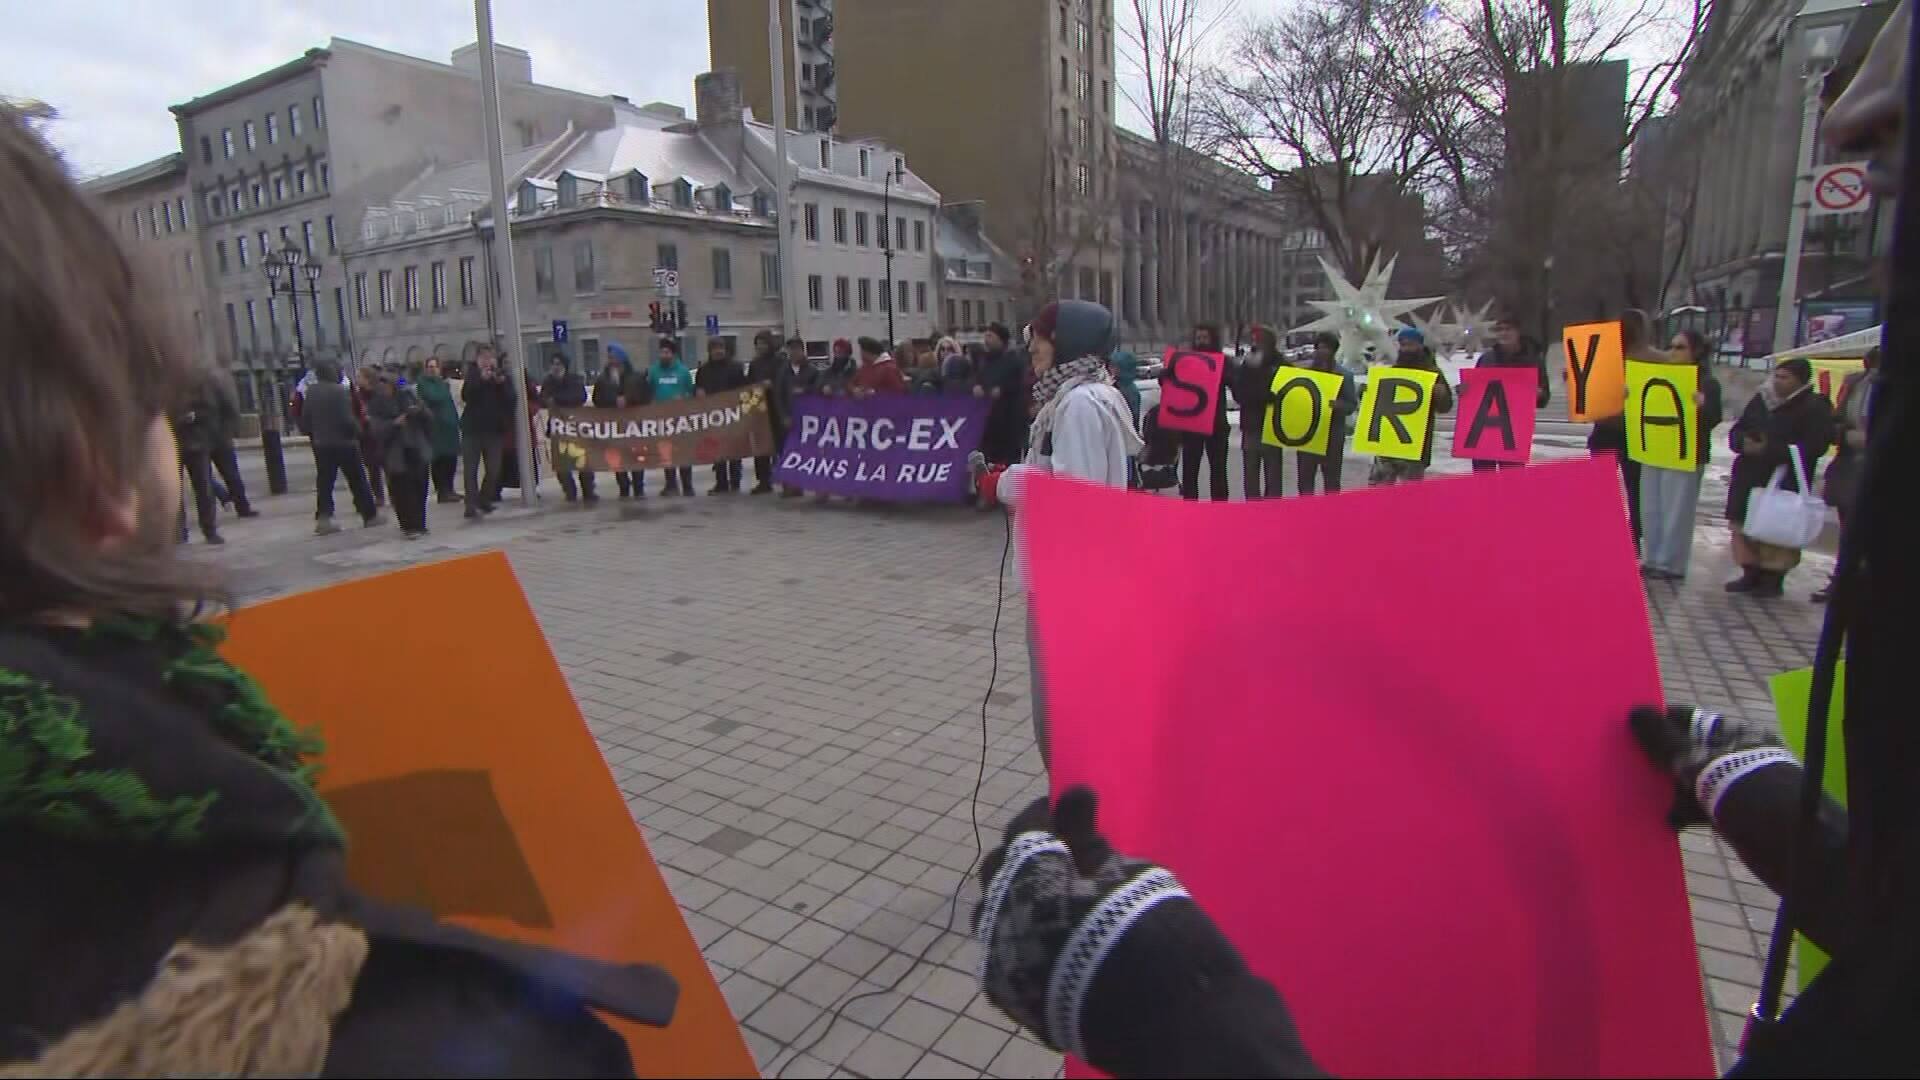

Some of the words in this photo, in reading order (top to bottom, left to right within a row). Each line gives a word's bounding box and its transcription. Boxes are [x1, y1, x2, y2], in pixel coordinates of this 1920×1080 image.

[1167, 351, 1216, 417] S
[1567, 334, 1600, 414] Y
[551, 406, 740, 439] RÉGULARISATION
[801, 415, 966, 450] PARC-EX
[1272, 377, 1322, 446] O
[1368, 378, 1424, 444] R
[1464, 380, 1516, 450] A
[1641, 377, 1687, 460] A
[782, 453, 848, 478] DANS
[855, 460, 886, 481] LA
[897, 463, 952, 483] RUE
